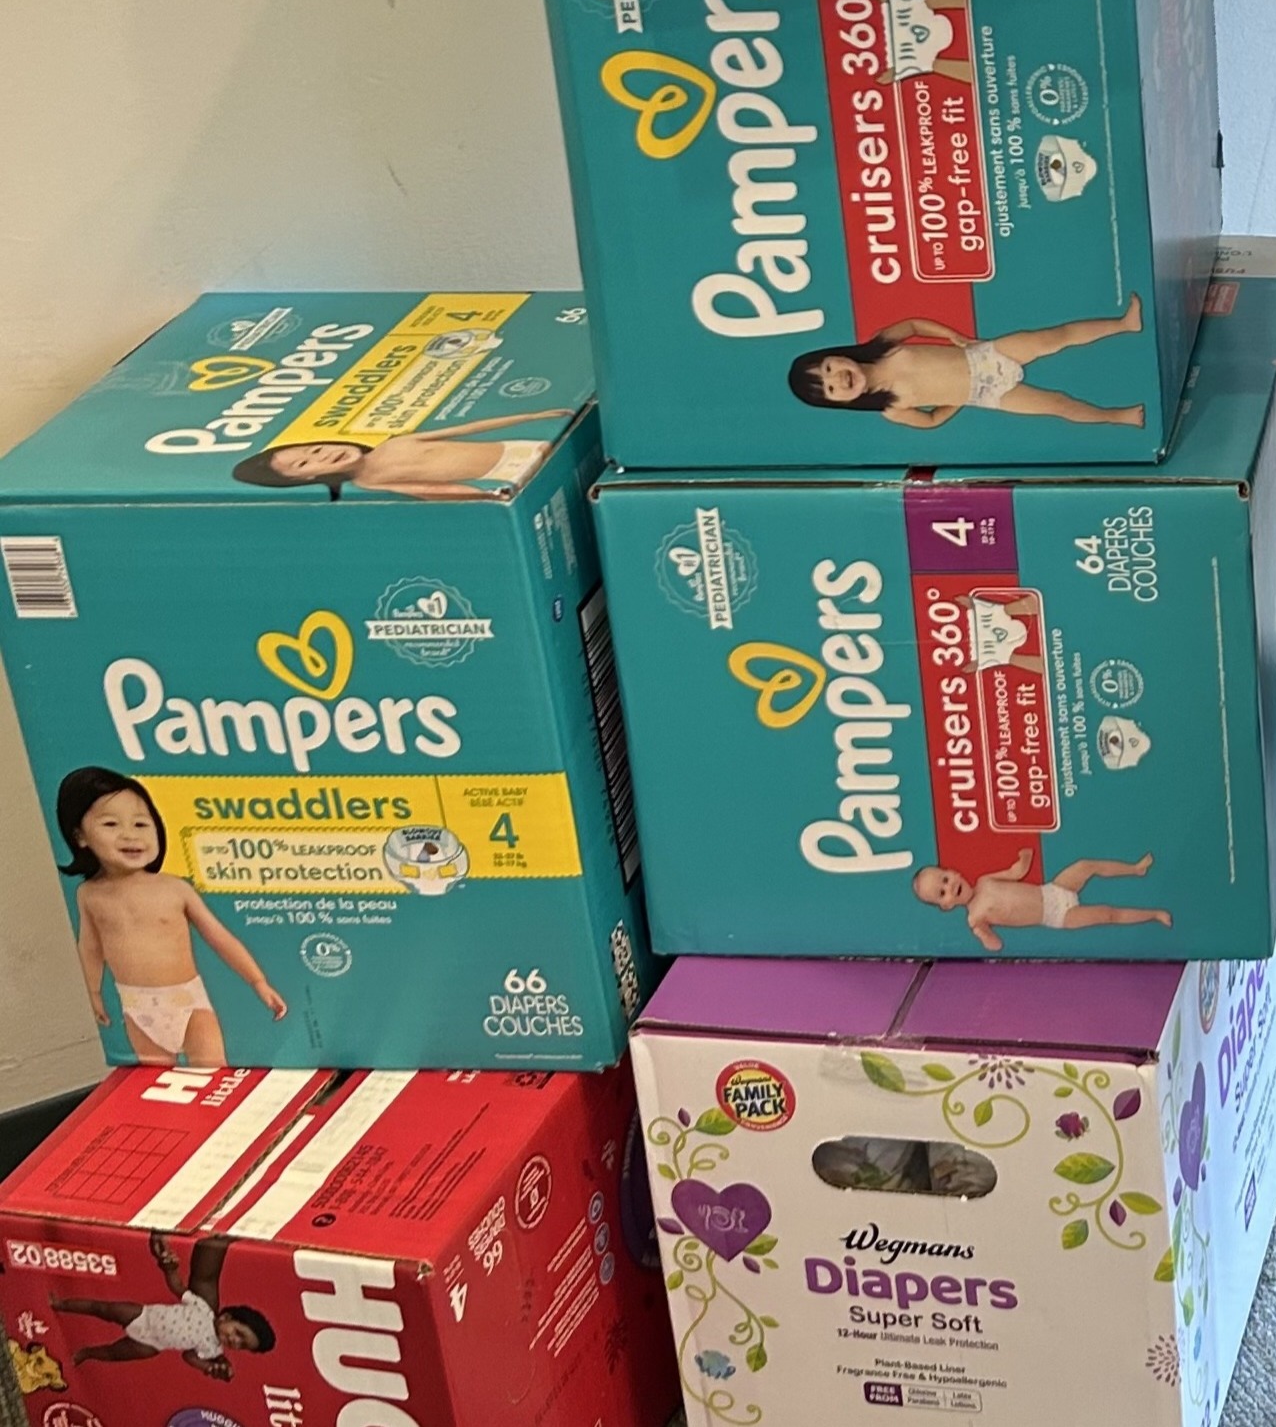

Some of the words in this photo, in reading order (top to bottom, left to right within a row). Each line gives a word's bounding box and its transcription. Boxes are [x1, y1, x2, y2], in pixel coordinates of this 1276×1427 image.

[981, 26, 1000, 104] ouverture
[1006, 55, 1017, 88] fuites
[942, 96, 964, 123] fit
[1009, 91, 1020, 115] sans
[915, 81, 938, 174] LEAKPROOF
[989, 106, 1002, 145] sans
[1009, 136, 1024, 164] 100
[851, 88, 901, 284] cruisers
[949, 133, 984, 251] gap-free
[990, 148, 1014, 237] ajustement
[918, 175, 949, 242] 100%
[934, 256, 945, 271] UP
[446, 310, 483, 323] 4
[555, 307, 587, 323] 66
[144, 322, 375, 455] Pampers
[314, 343, 417, 429] swaddlers
[415, 358, 468, 407] protection
[931, 517, 975, 547] 4
[703, 515, 729, 622] PEDIATRICIAN
[1075, 536, 1103, 574] 64
[1103, 517, 1131, 591] DIAPERS
[1128, 506, 1158, 602] COUCHES
[373, 624, 485, 636] PEDIATRICIAN
[927, 588, 965, 666] 360°
[1052, 628, 1064, 690] ouverture
[994, 671, 1011, 745] LEAKPROOF
[1017, 683, 1036, 707] fit
[1060, 694, 1070, 723] sans
[103, 658, 461, 772] Pampers
[799, 558, 914, 873] Pampers
[1073, 713, 1087, 737] 100
[938, 677, 979, 832] cruisers
[1021, 713, 1051, 808] gap-free
[1056, 726, 1075, 797] ajustement
[996, 747, 1020, 798] 100%
[193, 787, 412, 820] swaddlers
[463, 788, 500, 797] ACTIVE
[502, 787, 528, 796] BABY
[489, 812, 519, 848] 4
[227, 838, 289, 860] 100%
[291, 845, 376, 856] LEAKPROOF
[206, 862, 251, 881] skin
[259, 862, 383, 884] protection
[234, 898, 312, 912] protection
[316, 898, 335, 910] de
[339, 898, 354, 910] la
[357, 900, 397, 912] peau
[287, 912, 315, 924] 100
[504, 968, 547, 994] 66
[490, 994, 569, 1015] DIAPERS
[483, 1016, 584, 1036] COUCHES
[1218, 958, 1270, 1108] Diape
[140, 1067, 221, 1104] H
[200, 1068, 251, 1107] little
[723, 1083, 783, 1103] FAMILY
[735, 1098, 786, 1118] PACK
[10, 1243, 42, 1266] 02
[483, 1240, 503, 1276] 66
[839, 1222, 975, 1265] Wegmans
[44, 1248, 117, 1276] 53588
[804, 1255, 1018, 1310] Diapers
[449, 1283, 468, 1323] 4
[849, 1305, 924, 1330] Super
[931, 1312, 983, 1334] Soft
[837, 1327, 878, 1341] 12-Hour
[880, 1331, 921, 1345] Ultimate
[923, 1334, 947, 1347] Leak
[949, 1336, 1000, 1351] Protection
[836, 1365, 890, 1379] Fragrance
[892, 1370, 917, 1381] Free
[928, 1373, 1008, 1390] Hypoallergenic
[874, 1358, 938, 1373] Plant-Based
[939, 1364, 967, 1374] Liner
[869, 1384, 897, 1395] FREE
[869, 1393, 900, 1404] FROM
